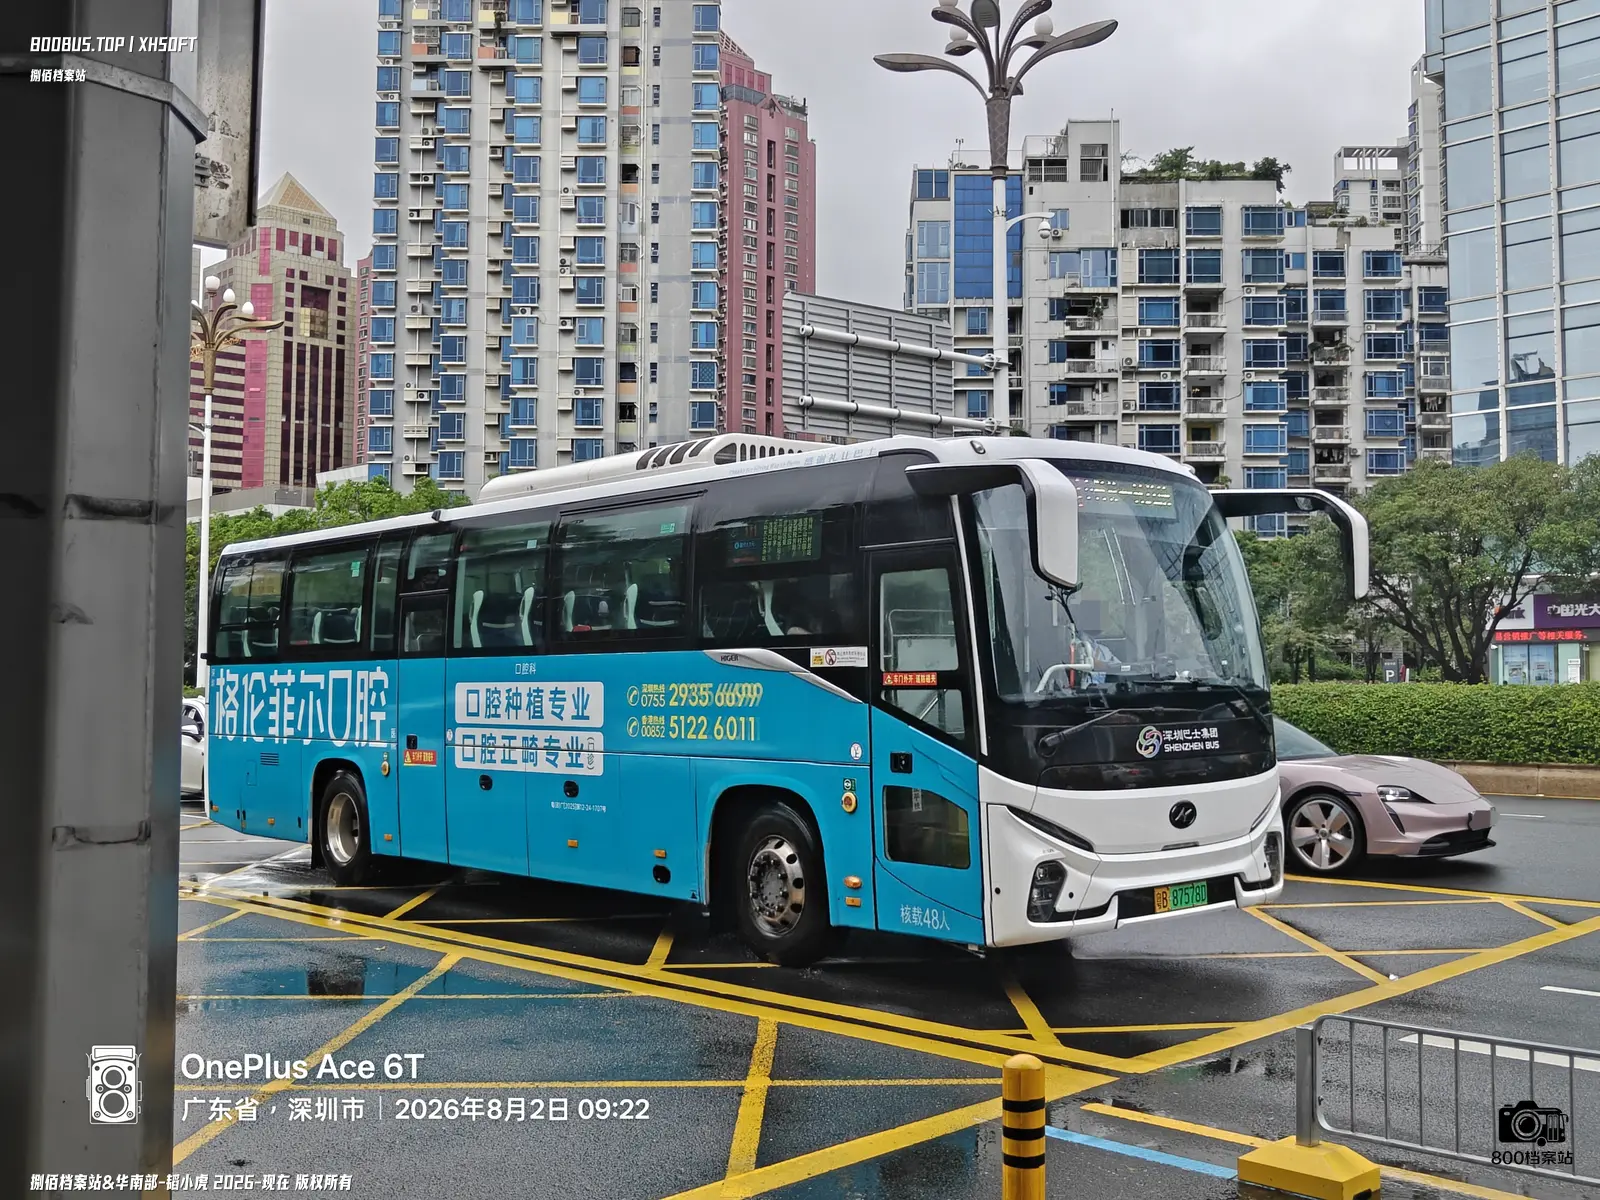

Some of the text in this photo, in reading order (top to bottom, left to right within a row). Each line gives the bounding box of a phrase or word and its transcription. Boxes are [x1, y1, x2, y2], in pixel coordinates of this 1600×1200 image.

[720, 654, 739, 662] HIGER
[515, 663, 537, 675] 口腔科
[1385, 669, 1395, 682] P
[641, 694, 666, 707] 0755
[669, 683, 711, 707] 2935
[214, 666, 389, 748] 格伦菲尔口腔
[466, 686, 591, 721] 口腔种植专业
[641, 715, 665, 725] 香港热线
[641, 725, 665, 738] 00852
[669, 715, 755, 741] 5122 6011
[1162, 727, 1219, 742] 深圳巴士集团
[462, 732, 584, 769] 口腔正畸专业
[1164, 740, 1220, 753] SHENZHEN BUS
[900, 904, 951, 931] 核载48人
